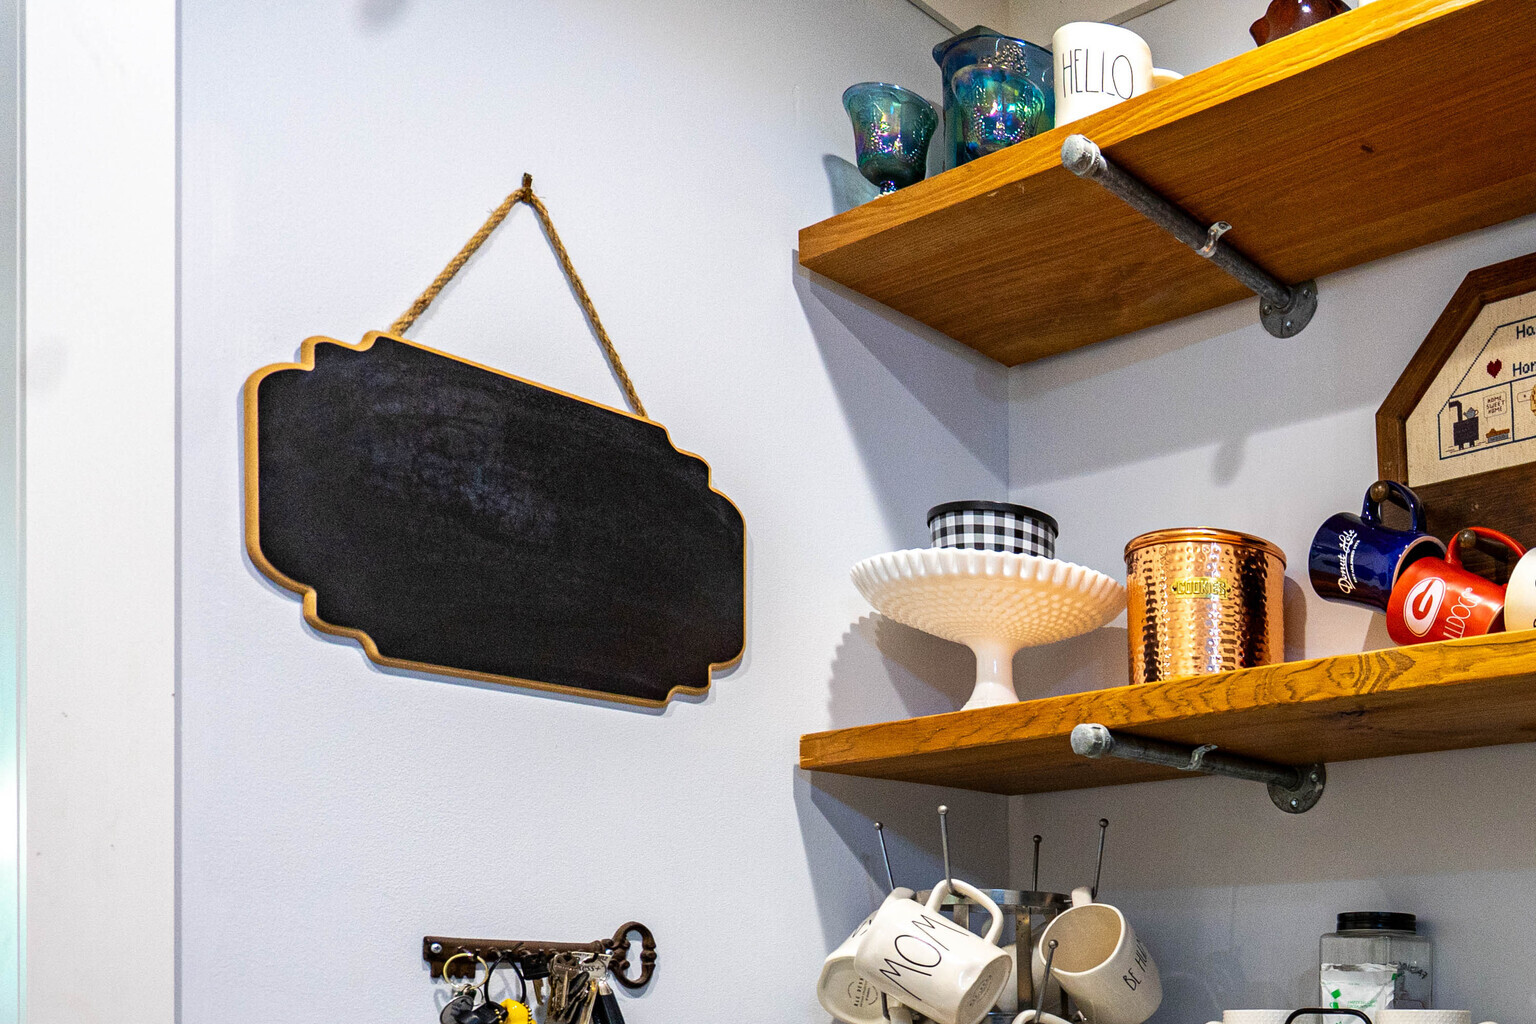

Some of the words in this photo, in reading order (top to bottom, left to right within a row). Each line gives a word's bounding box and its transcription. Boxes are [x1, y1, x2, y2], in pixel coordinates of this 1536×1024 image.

[1062, 48, 1134, 100] HELLO
[1338, 529, 1357, 554] Hole
[1176, 581, 1227, 597] COOKIES
[1337, 552, 1354, 594] Donut
[879, 914, 970, 1002] MOM
[1122, 967, 1142, 991] BE
